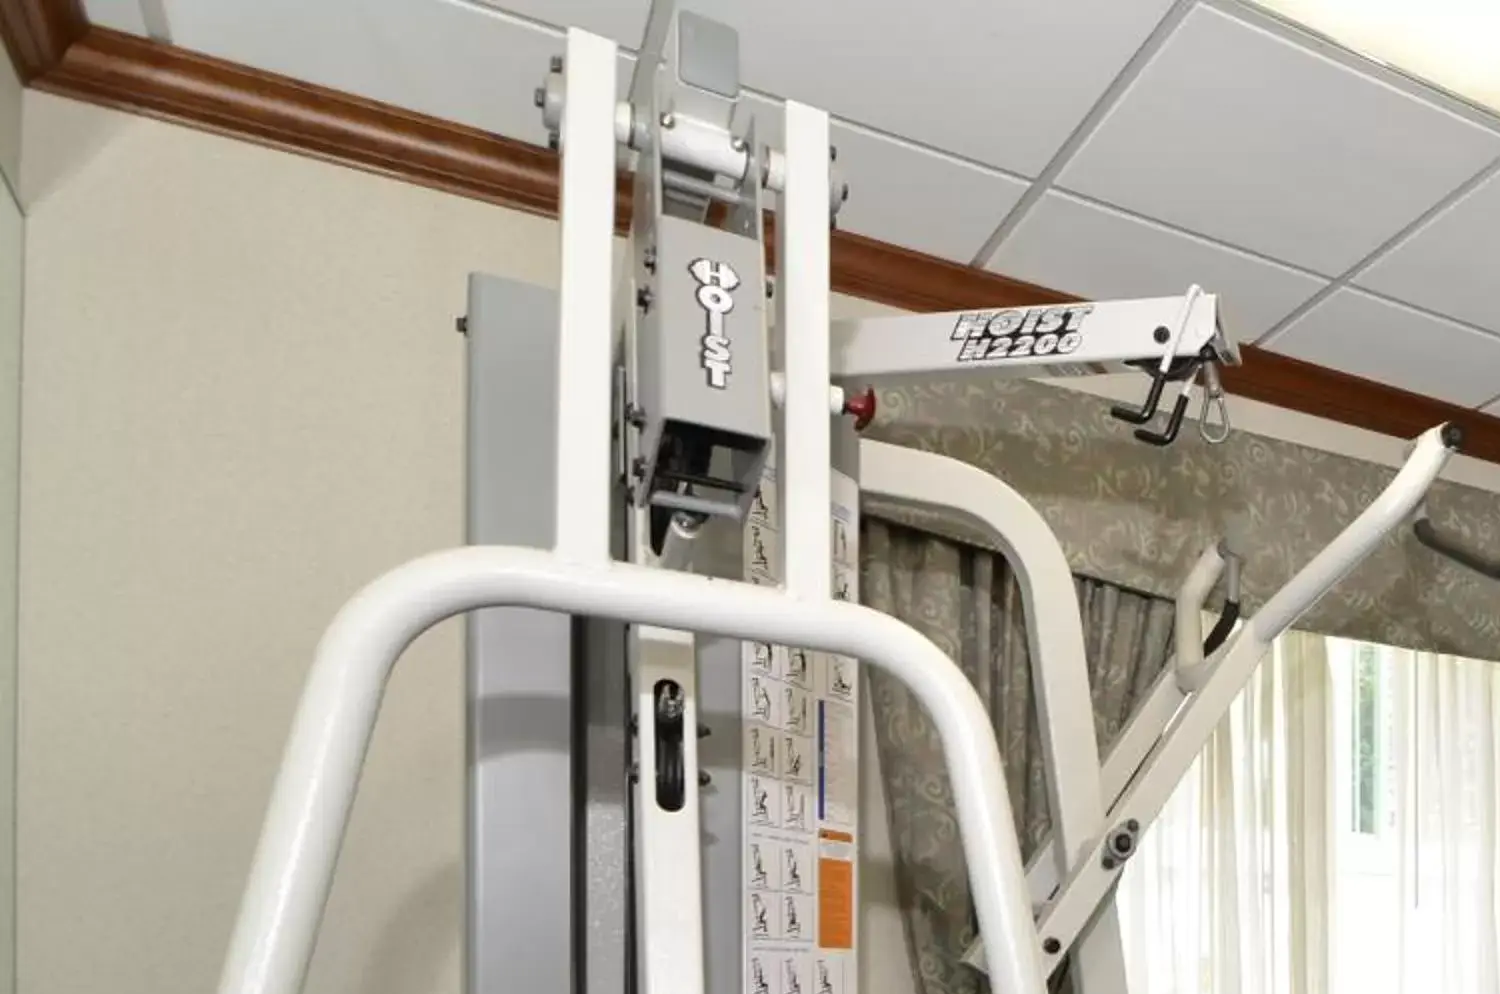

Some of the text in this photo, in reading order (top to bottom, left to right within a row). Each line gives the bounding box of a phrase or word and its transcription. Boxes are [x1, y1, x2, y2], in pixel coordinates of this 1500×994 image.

[687, 257, 741, 390] HOIST
[950, 305, 1094, 341] HOIST
[956, 332, 1083, 362] H2200
